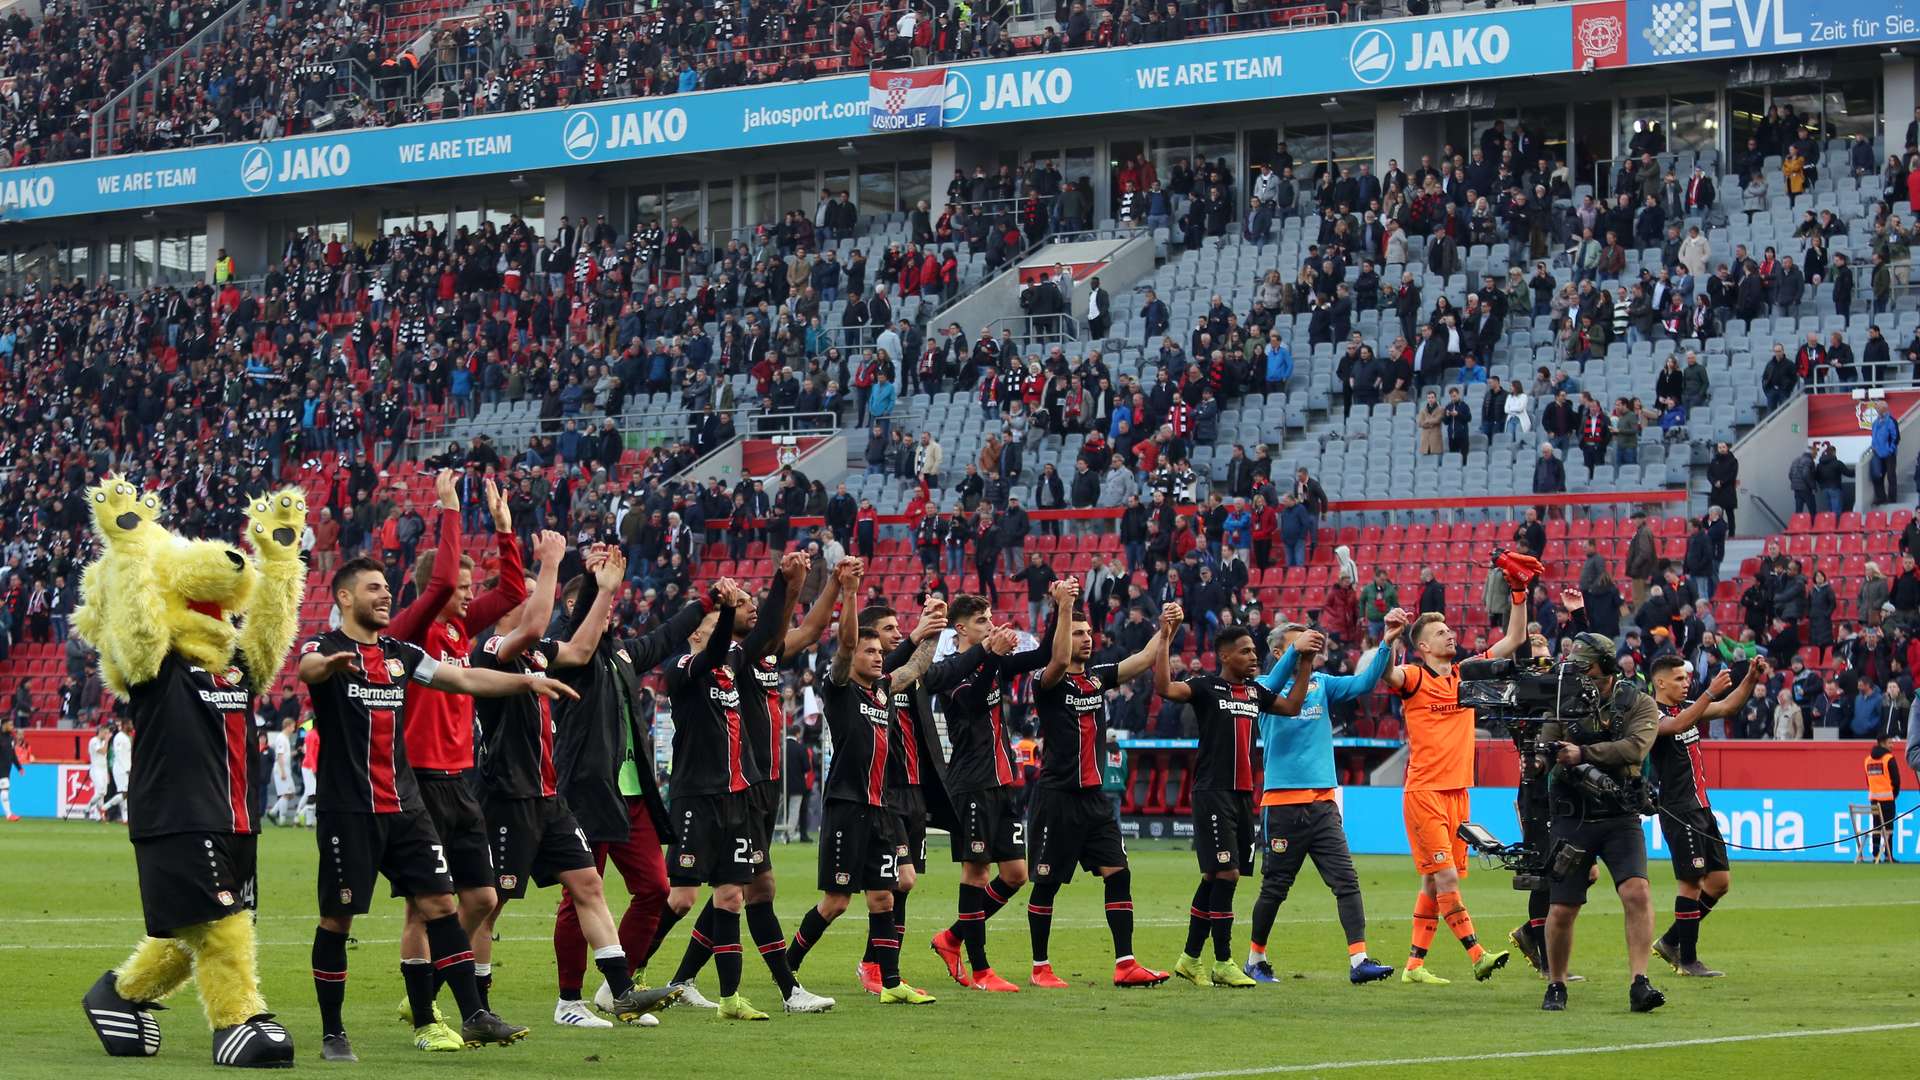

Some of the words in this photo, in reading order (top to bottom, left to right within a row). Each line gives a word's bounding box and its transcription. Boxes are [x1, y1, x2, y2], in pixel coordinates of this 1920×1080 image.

[1701, 0, 1802, 51] EVL
[1810, 21, 1847, 42] Zeit
[1852, 18, 1880, 38] für
[1885, 14, 1920, 35] Sie.
[1405, 24, 1510, 72] JAKO
[979, 67, 1073, 111] JAKO
[1136, 66, 1170, 89] WE
[1175, 61, 1219, 86] ARE
[1222, 55, 1283, 81] TEAM
[606, 107, 688, 149] JAKO
[742, 99, 870, 133] jakosport.com
[278, 143, 350, 182] JAKO
[399, 144, 425, 164] WE
[428, 140, 462, 161] ARE
[464, 135, 512, 157] TEAM
[97, 176, 120, 194] WE
[123, 171, 153, 191] ARE
[155, 167, 197, 188] TEAM
[347, 683, 404, 699] Barmenia
[1219, 699, 1259, 713] Barmenia
[431, 844, 448, 874] 3
